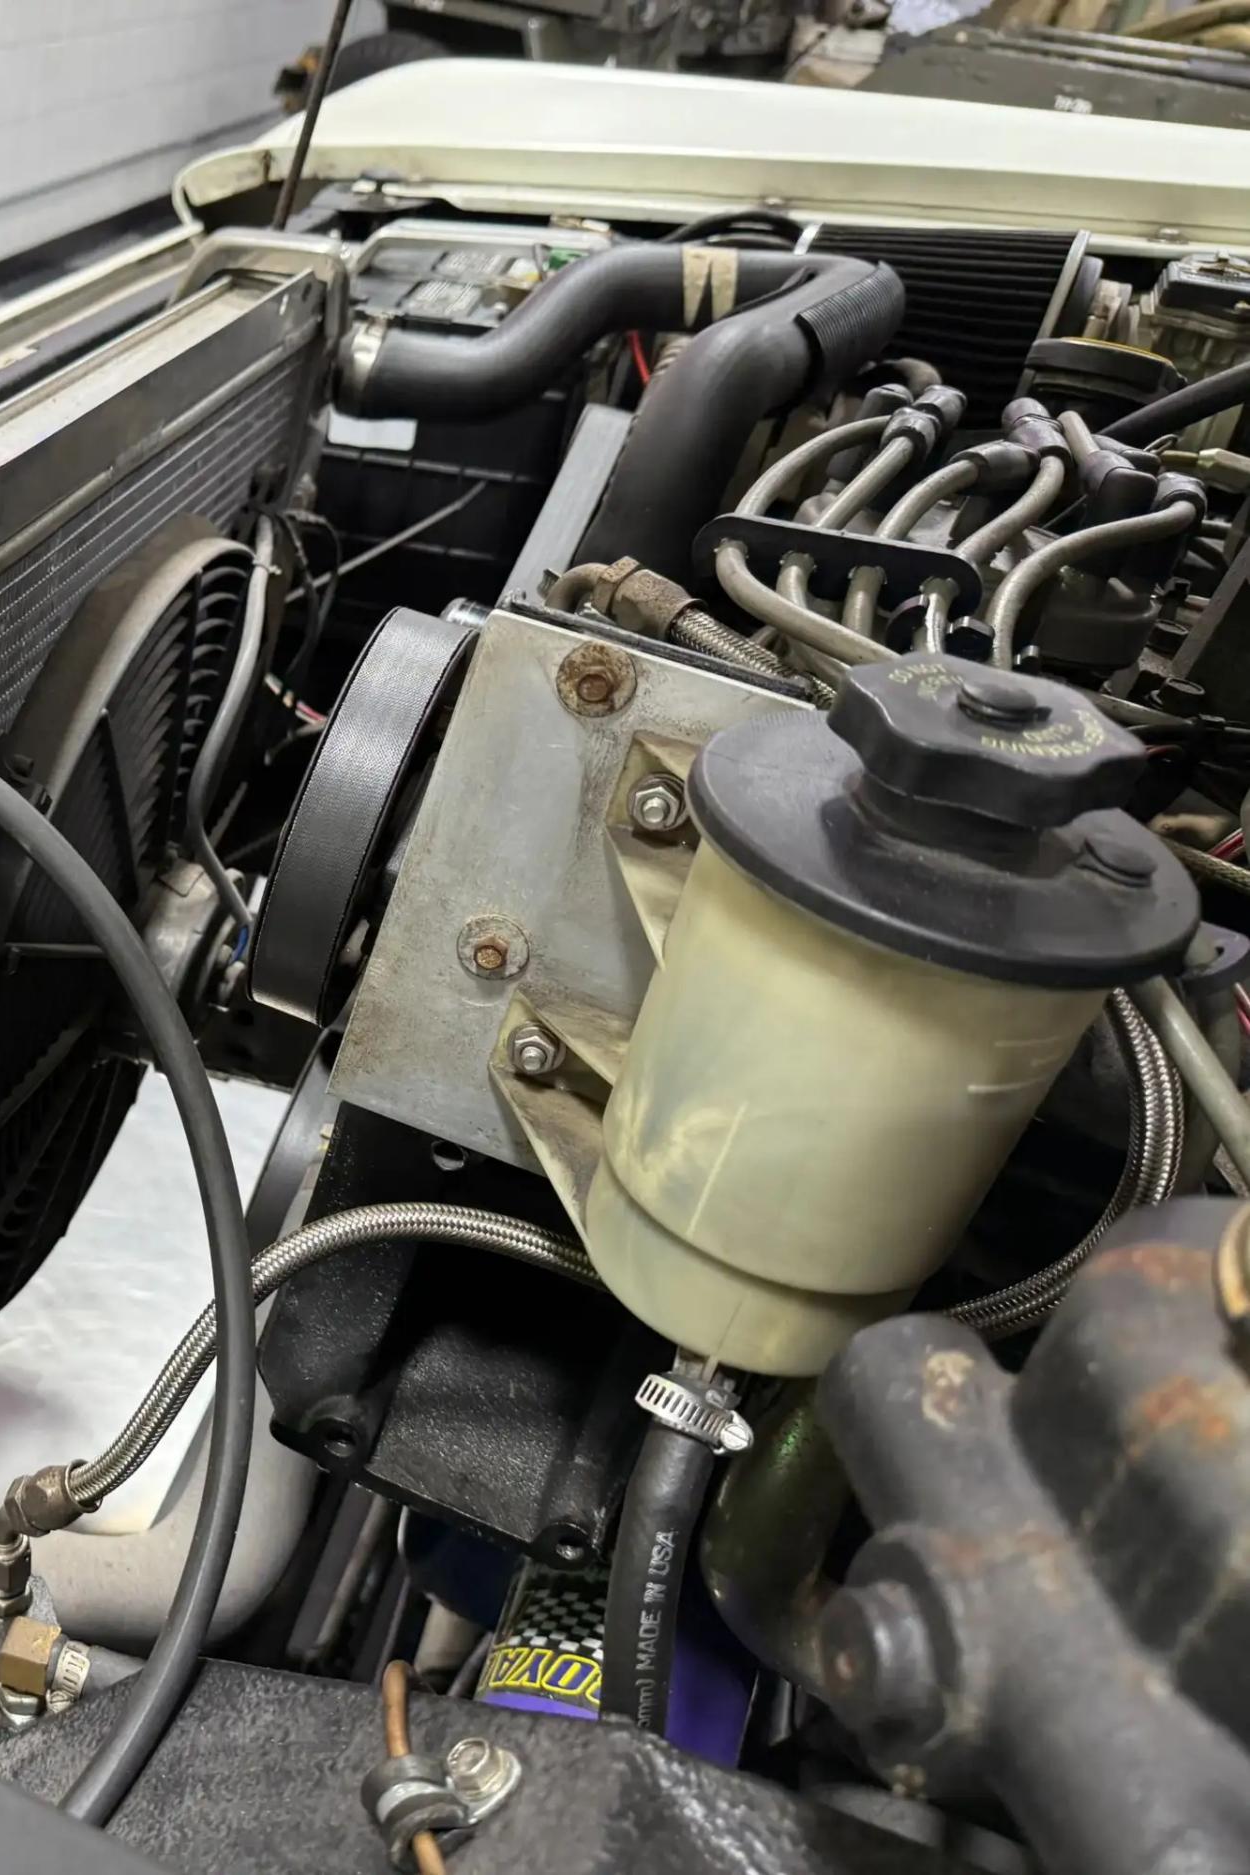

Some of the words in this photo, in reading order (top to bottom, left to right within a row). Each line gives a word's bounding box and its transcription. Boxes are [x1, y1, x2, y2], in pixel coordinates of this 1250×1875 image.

[648, 1530, 677, 1577] USA
[644, 1581, 668, 1605] IN
[636, 1610, 662, 1671] MADE
